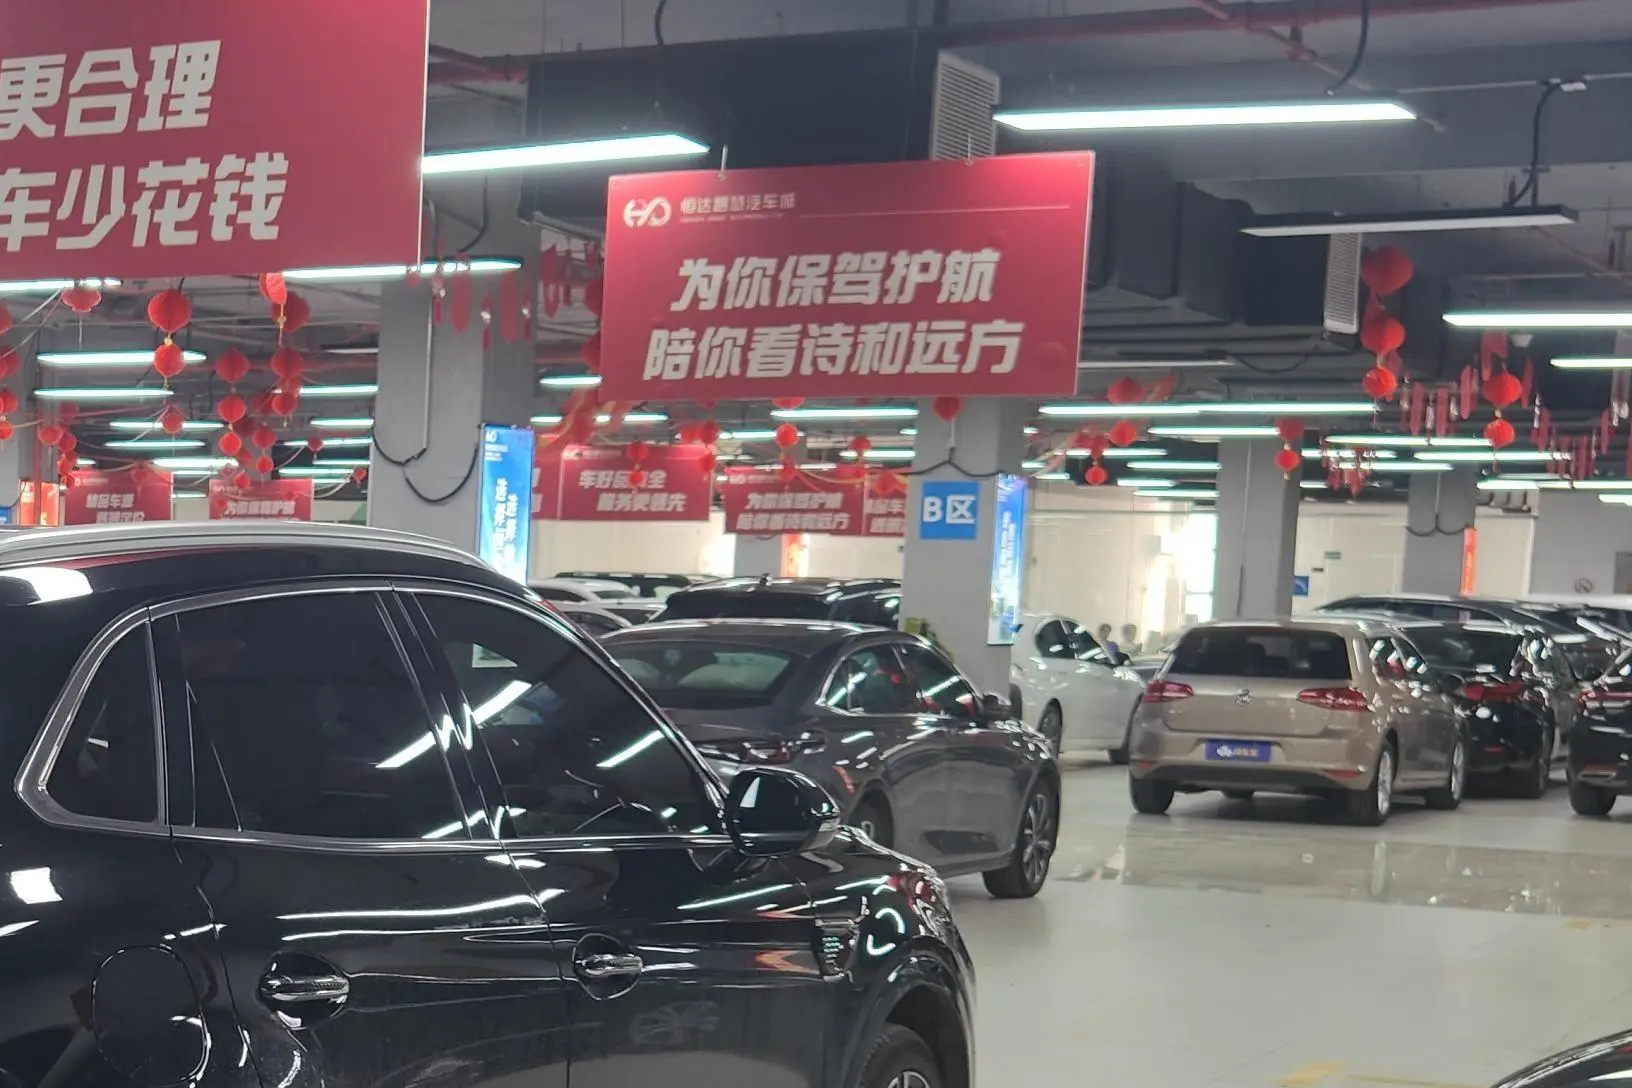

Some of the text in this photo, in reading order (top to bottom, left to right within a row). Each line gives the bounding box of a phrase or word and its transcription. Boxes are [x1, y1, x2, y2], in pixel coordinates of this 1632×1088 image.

[671, 248, 1000, 312] 为你保驾护航
[643, 319, 1025, 380] 陪你看诗和远方
[923, 495, 976, 524] B区
